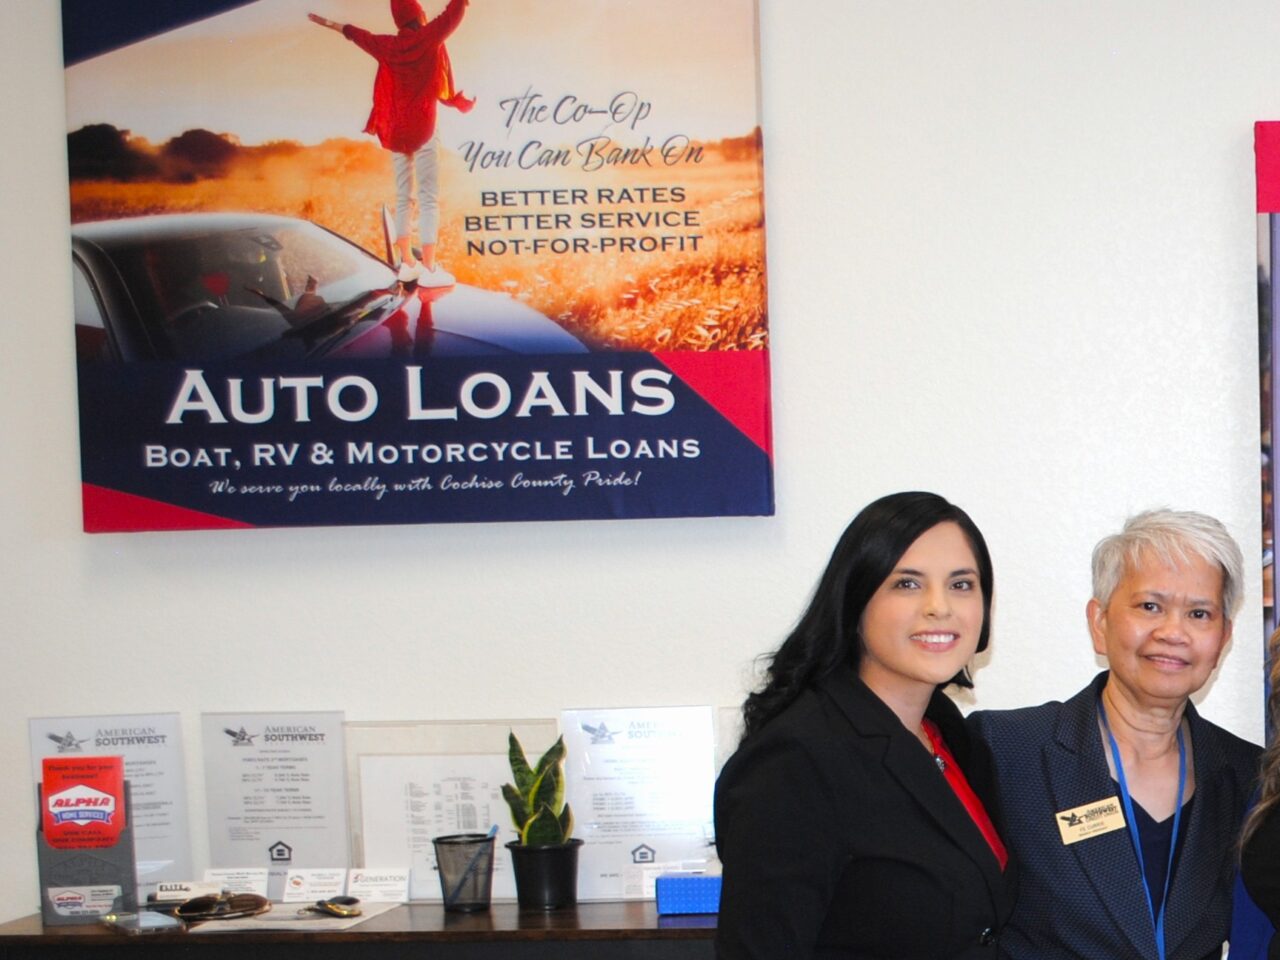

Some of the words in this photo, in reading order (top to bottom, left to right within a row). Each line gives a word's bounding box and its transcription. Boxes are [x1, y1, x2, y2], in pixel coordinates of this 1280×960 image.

[500, 85, 548, 137] The
[458, 141, 512, 173] You
[518, 140, 572, 170] Can
[576, 136, 653, 172] Bank
[661, 134, 704, 166] On
[481, 188, 588, 207] BETTER
[598, 187, 686, 203] RATES
[465, 213, 571, 231] BETTER
[580, 211, 700, 228] SERVICE
[467, 235, 703, 256] NOT-FOR-PROFIT
[165, 369, 379, 424] AUTO
[406, 366, 675, 421] LOANS
[145, 444, 241, 470] BOAT,
[254, 443, 300, 466] RV
[311, 442, 334, 465] &
[348, 440, 573, 465] MOTORCYCLE
[587, 437, 700, 459] LOANS
[209, 478, 237, 495] We
[241, 483, 284, 494] serve
[289, 483, 322, 502] you
[328, 476, 388, 500] locally
[394, 476, 433, 493] with
[440, 474, 504, 490] Cochise
[511, 472, 576, 496] County
[583, 470, 642, 487] Pride!
[95, 728, 156, 737] AMERICAN
[95, 735, 167, 747] SOUTHWEST
[264, 733, 325, 742] SOUTHWEST
[52, 797, 111, 808] ALPHA
